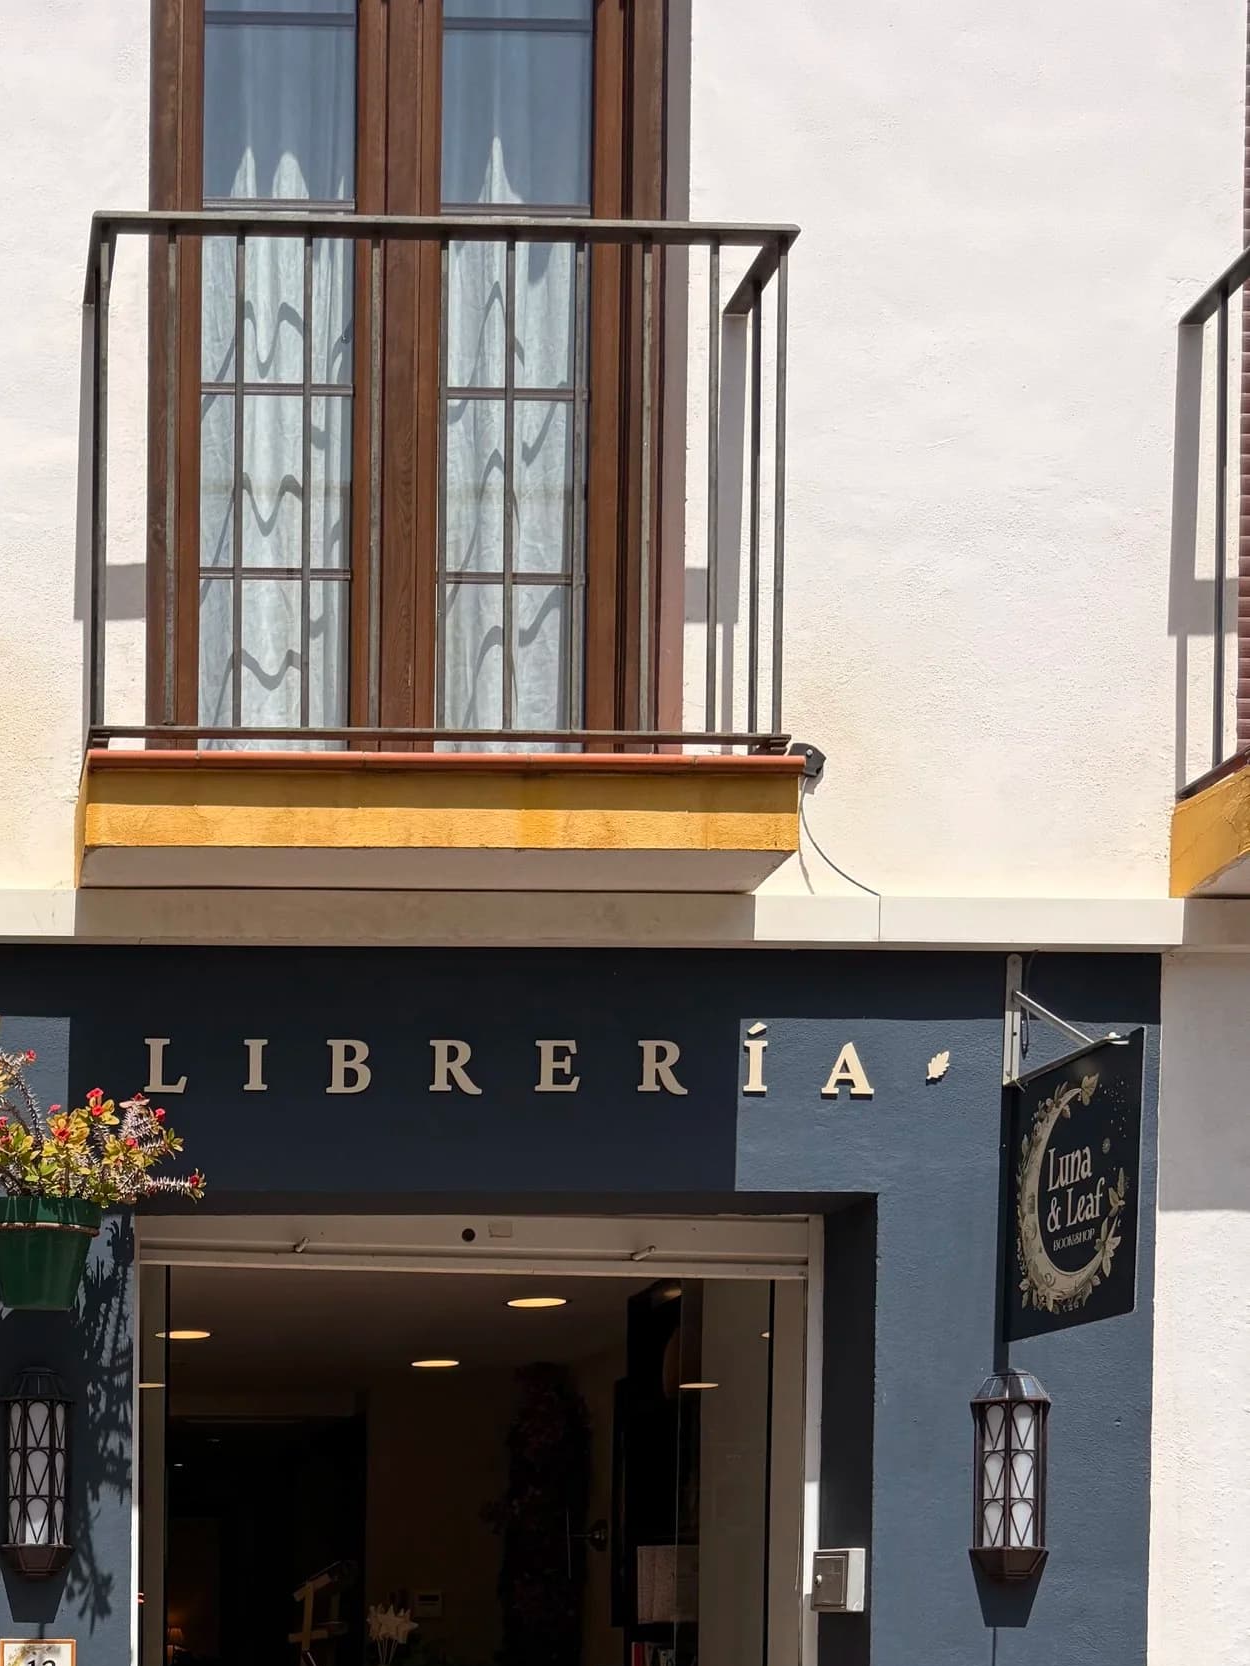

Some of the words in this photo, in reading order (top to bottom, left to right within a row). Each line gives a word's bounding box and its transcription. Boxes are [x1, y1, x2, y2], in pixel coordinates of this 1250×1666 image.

[144, 1022, 876, 1097] LIBRERÍA
[1048, 1146, 1092, 1192] Luna
[1047, 1197, 1061, 1232] &
[1066, 1177, 1105, 1227] Leaf
